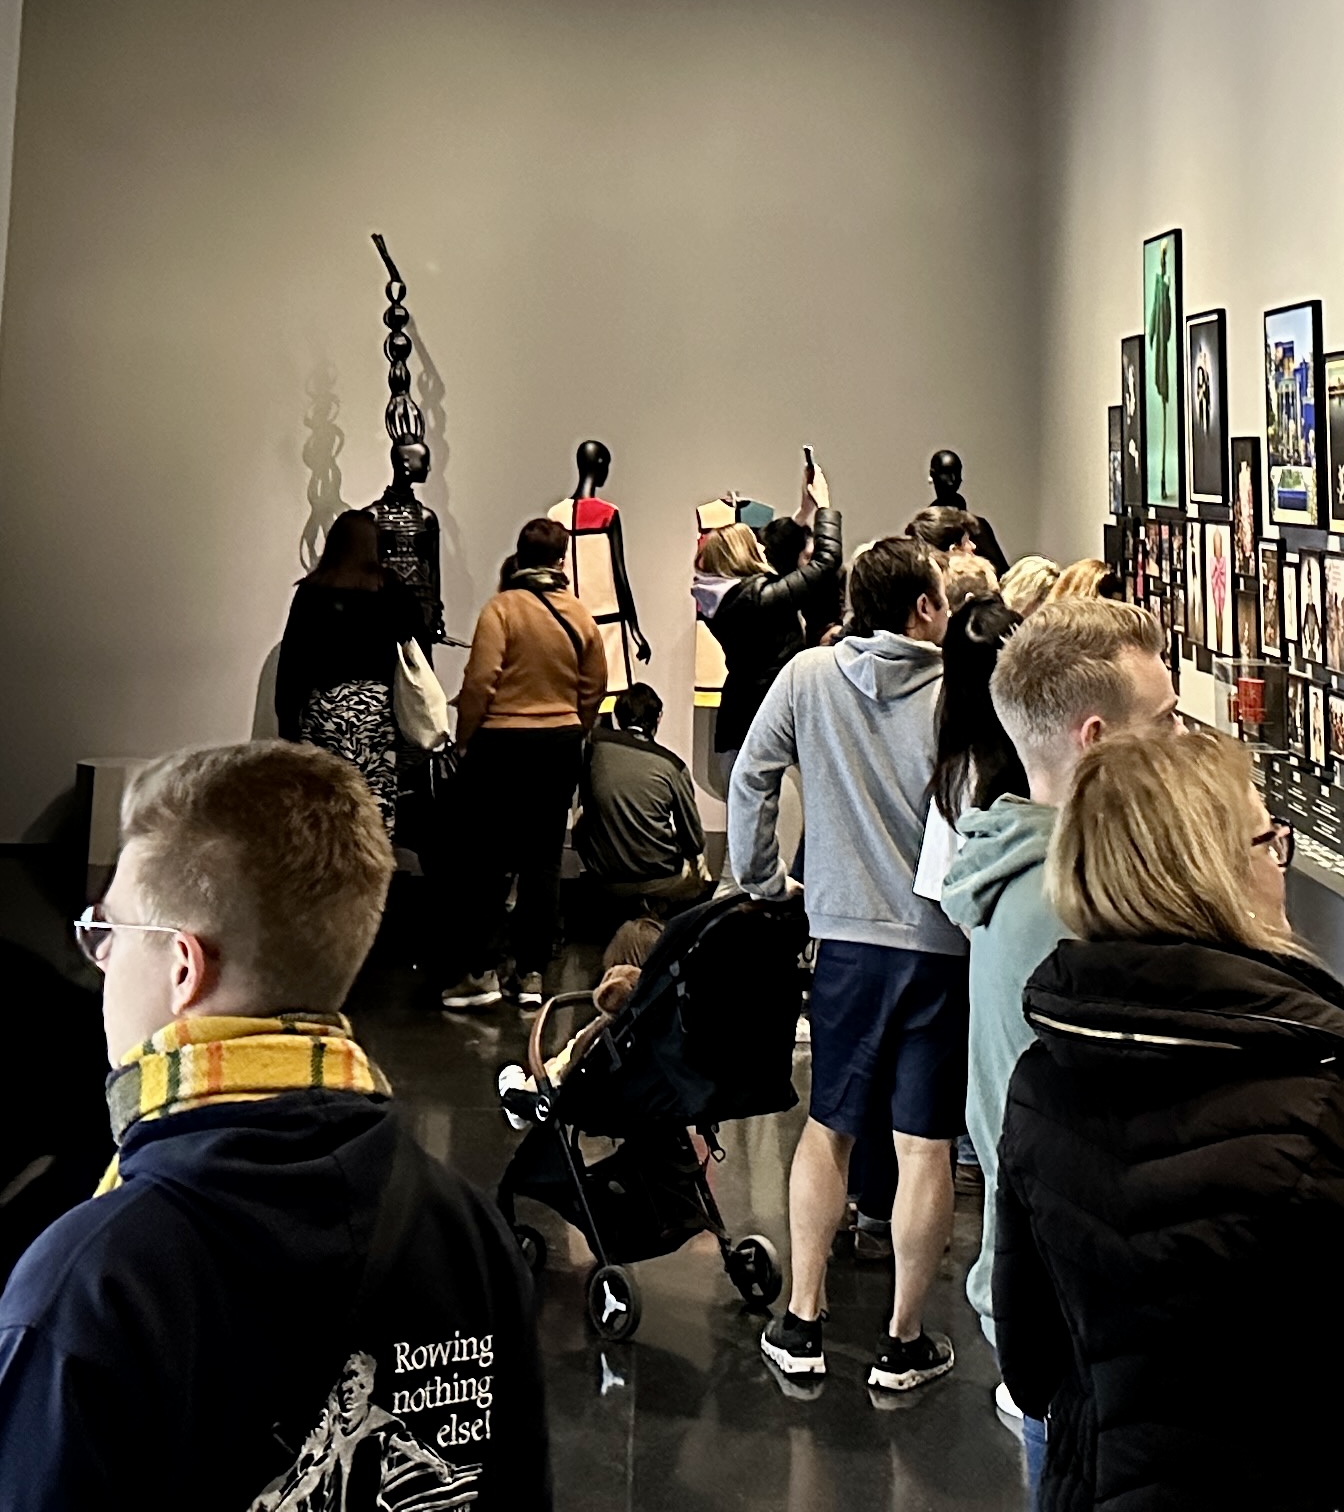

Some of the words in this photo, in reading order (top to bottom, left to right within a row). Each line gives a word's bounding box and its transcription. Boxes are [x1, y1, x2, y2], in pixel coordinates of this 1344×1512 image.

[393, 1330, 494, 1373] Rowing
[392, 1372, 494, 1414] nothing
[436, 1409, 491, 1448] else!
